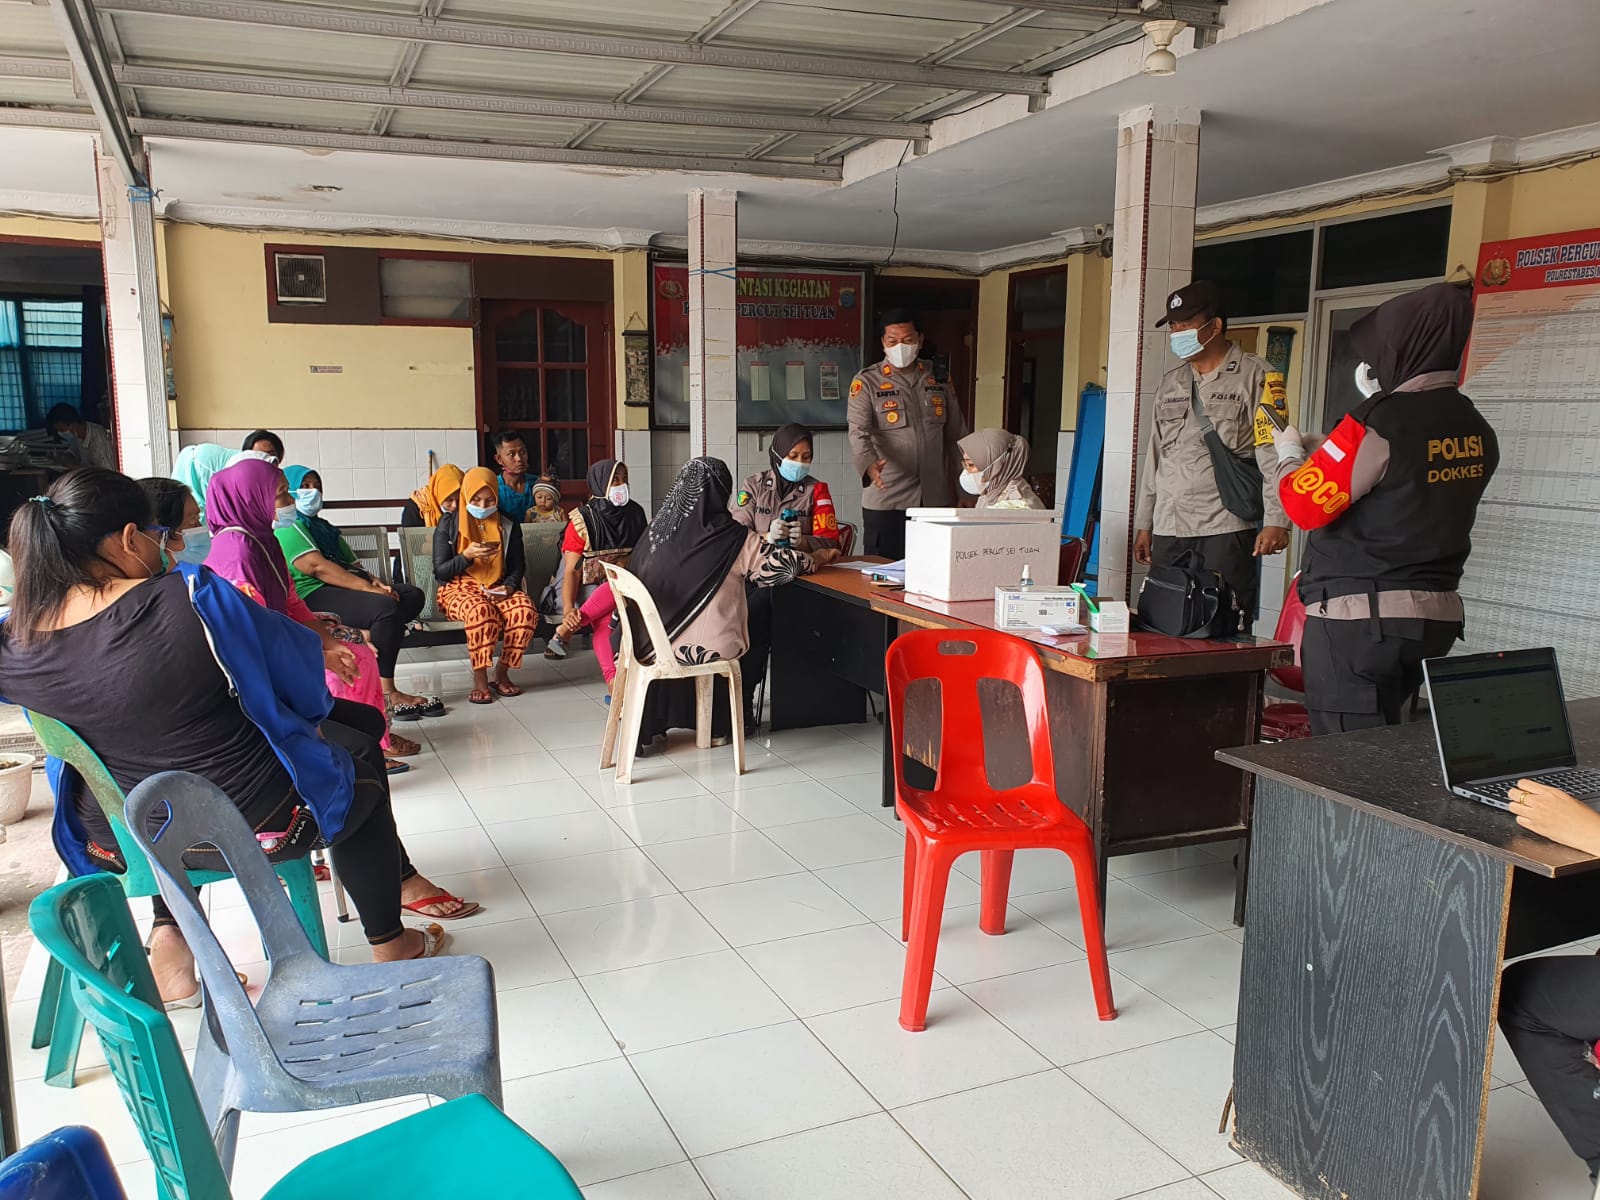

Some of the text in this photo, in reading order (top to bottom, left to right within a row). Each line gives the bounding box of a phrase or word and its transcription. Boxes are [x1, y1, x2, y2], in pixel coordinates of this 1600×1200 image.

[1516, 246, 1558, 268] POLSEK
[1545, 267, 1595, 282] POLRESTABES
[736, 277, 832, 299] NTASI KEGIATAN
[782, 304, 801, 319] SEI
[803, 305, 836, 320] TUAN
[1428, 435, 1484, 462] POLISI
[1428, 463, 1484, 484] DOKKES
